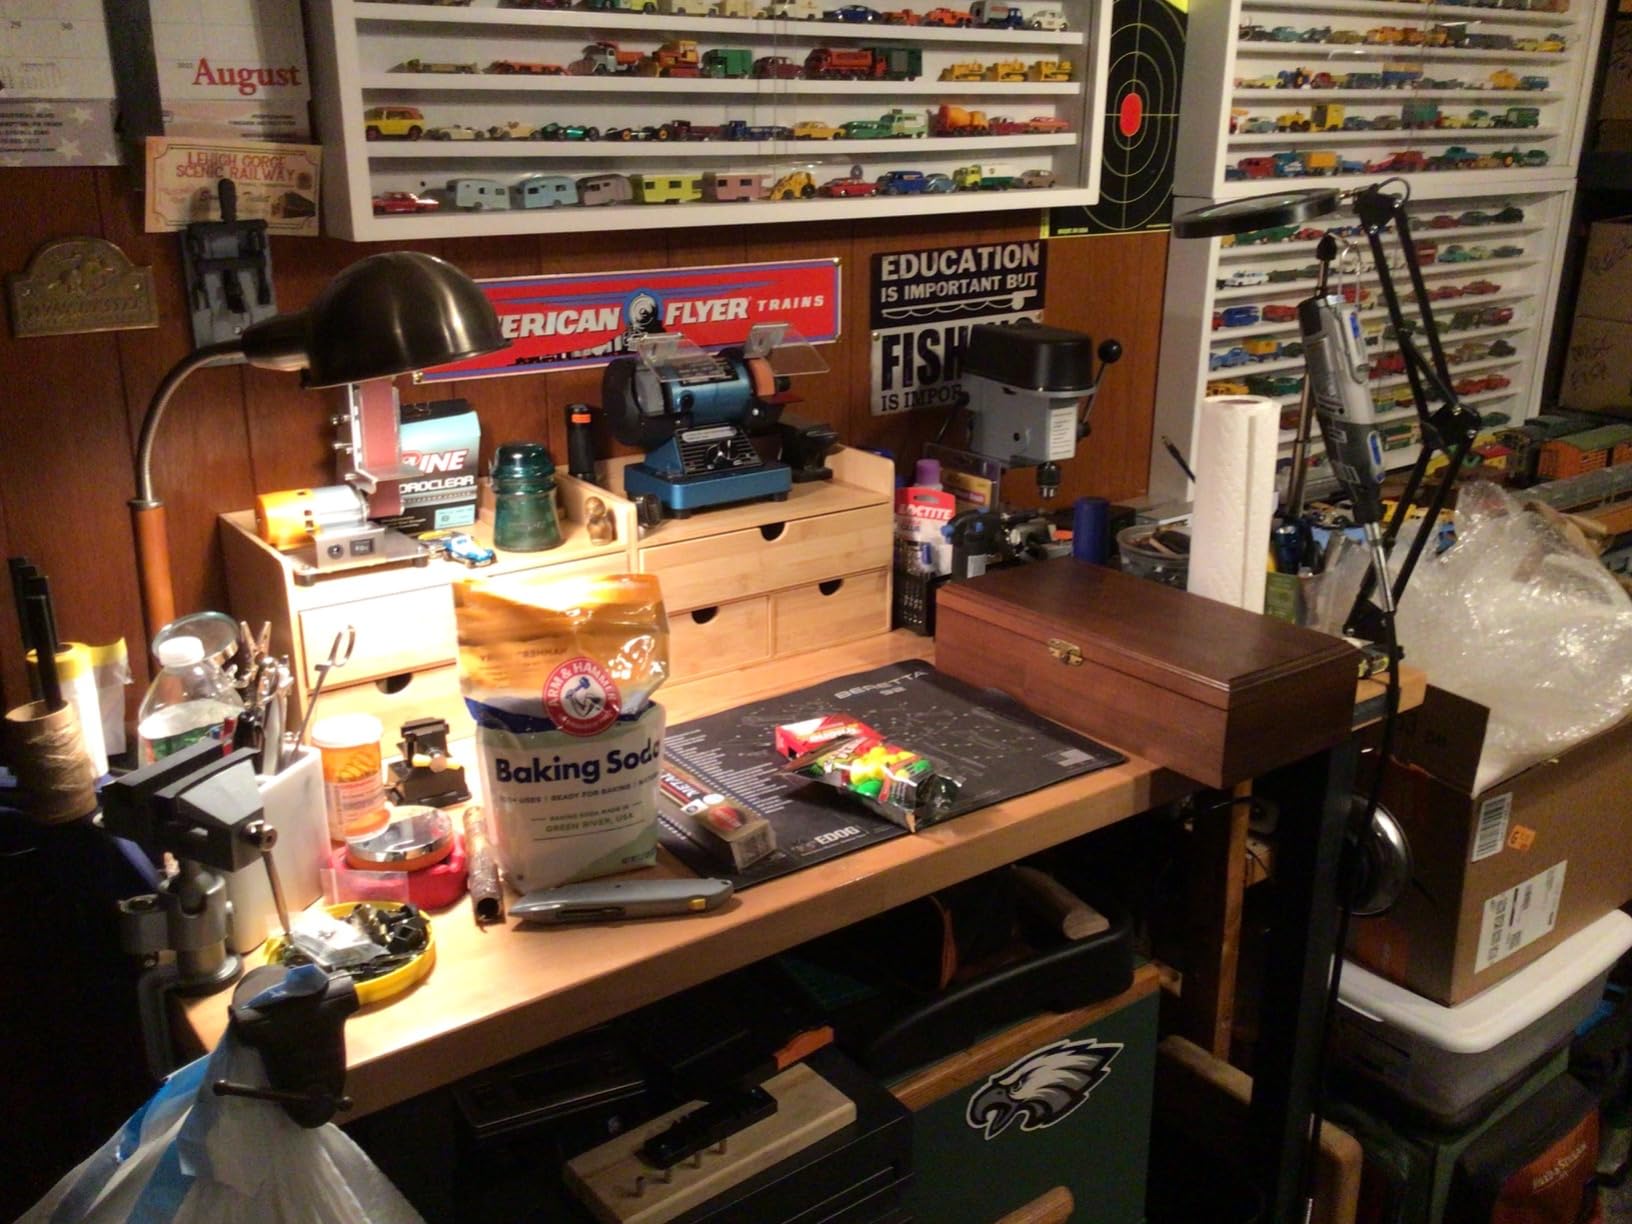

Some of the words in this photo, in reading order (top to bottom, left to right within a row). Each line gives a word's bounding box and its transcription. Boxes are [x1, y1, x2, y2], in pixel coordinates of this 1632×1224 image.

[192, 57, 302, 96] August
[176, 164, 224, 179] SCENIC
[230, 165, 296, 182] RAILWAY
[187, 151, 237, 168] LEHIGH
[242, 154, 287, 170] GORGE
[881, 242, 1040, 281] EDUCATION
[881, 287, 899, 303] IS
[904, 275, 1002, 300] IMPORTANT
[1006, 271, 1039, 290] BUT
[497, 307, 622, 339] ERICAN
[664, 297, 750, 326] FLYER
[757, 295, 825, 312] TRAINS
[881, 394, 899, 412] IS
[898, 503, 953, 521] LOCTITE
[547, 672, 563, 706] ARM
[560, 667, 573, 680] &
[573, 662, 618, 701] HAMMER
[834, 670, 929, 700] BERETTA
[495, 755, 600, 784] Baking
[581, 790, 599, 798] FOR
[545, 822, 580, 833] GREEN
